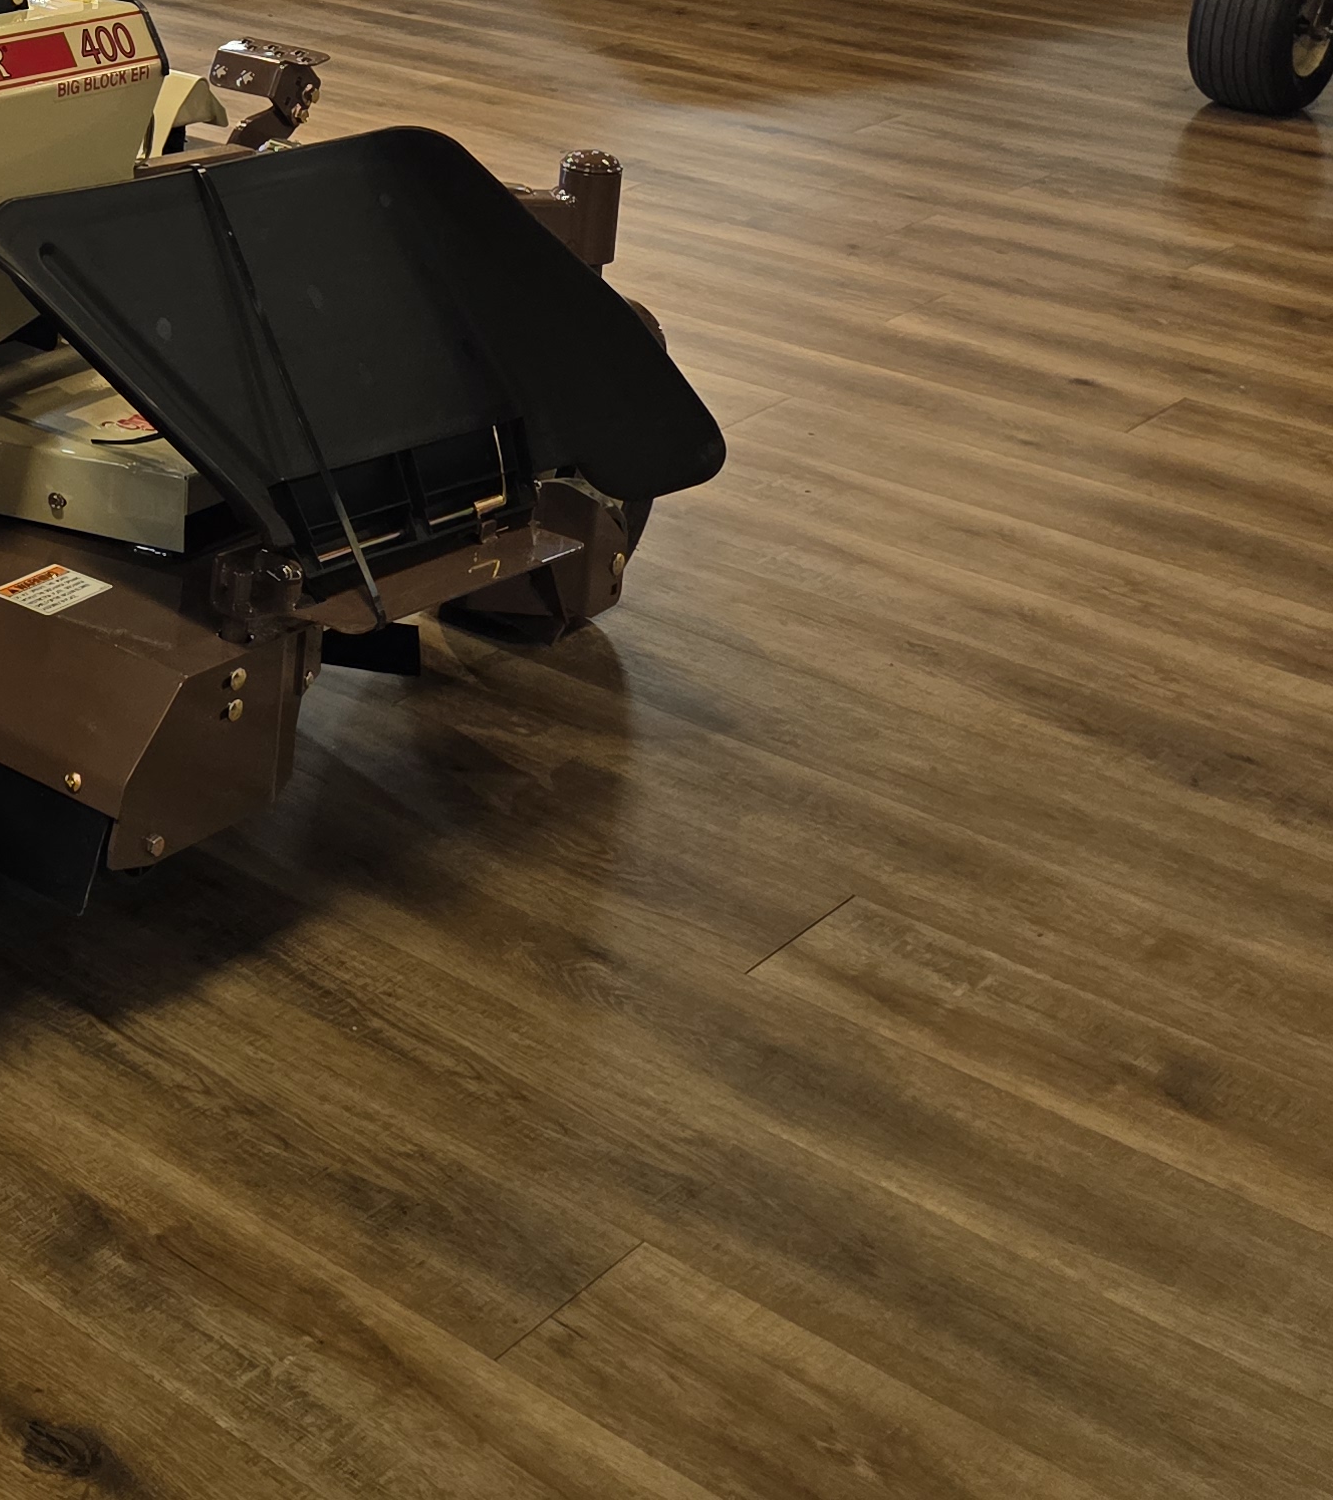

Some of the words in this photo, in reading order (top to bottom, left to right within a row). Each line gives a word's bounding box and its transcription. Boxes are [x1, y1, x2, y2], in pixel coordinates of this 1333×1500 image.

[80, 22, 136, 65] 400
[57, 80, 81, 99] BIG
[83, 71, 128, 94] BLOCK
[130, 65, 151, 85] EFI
